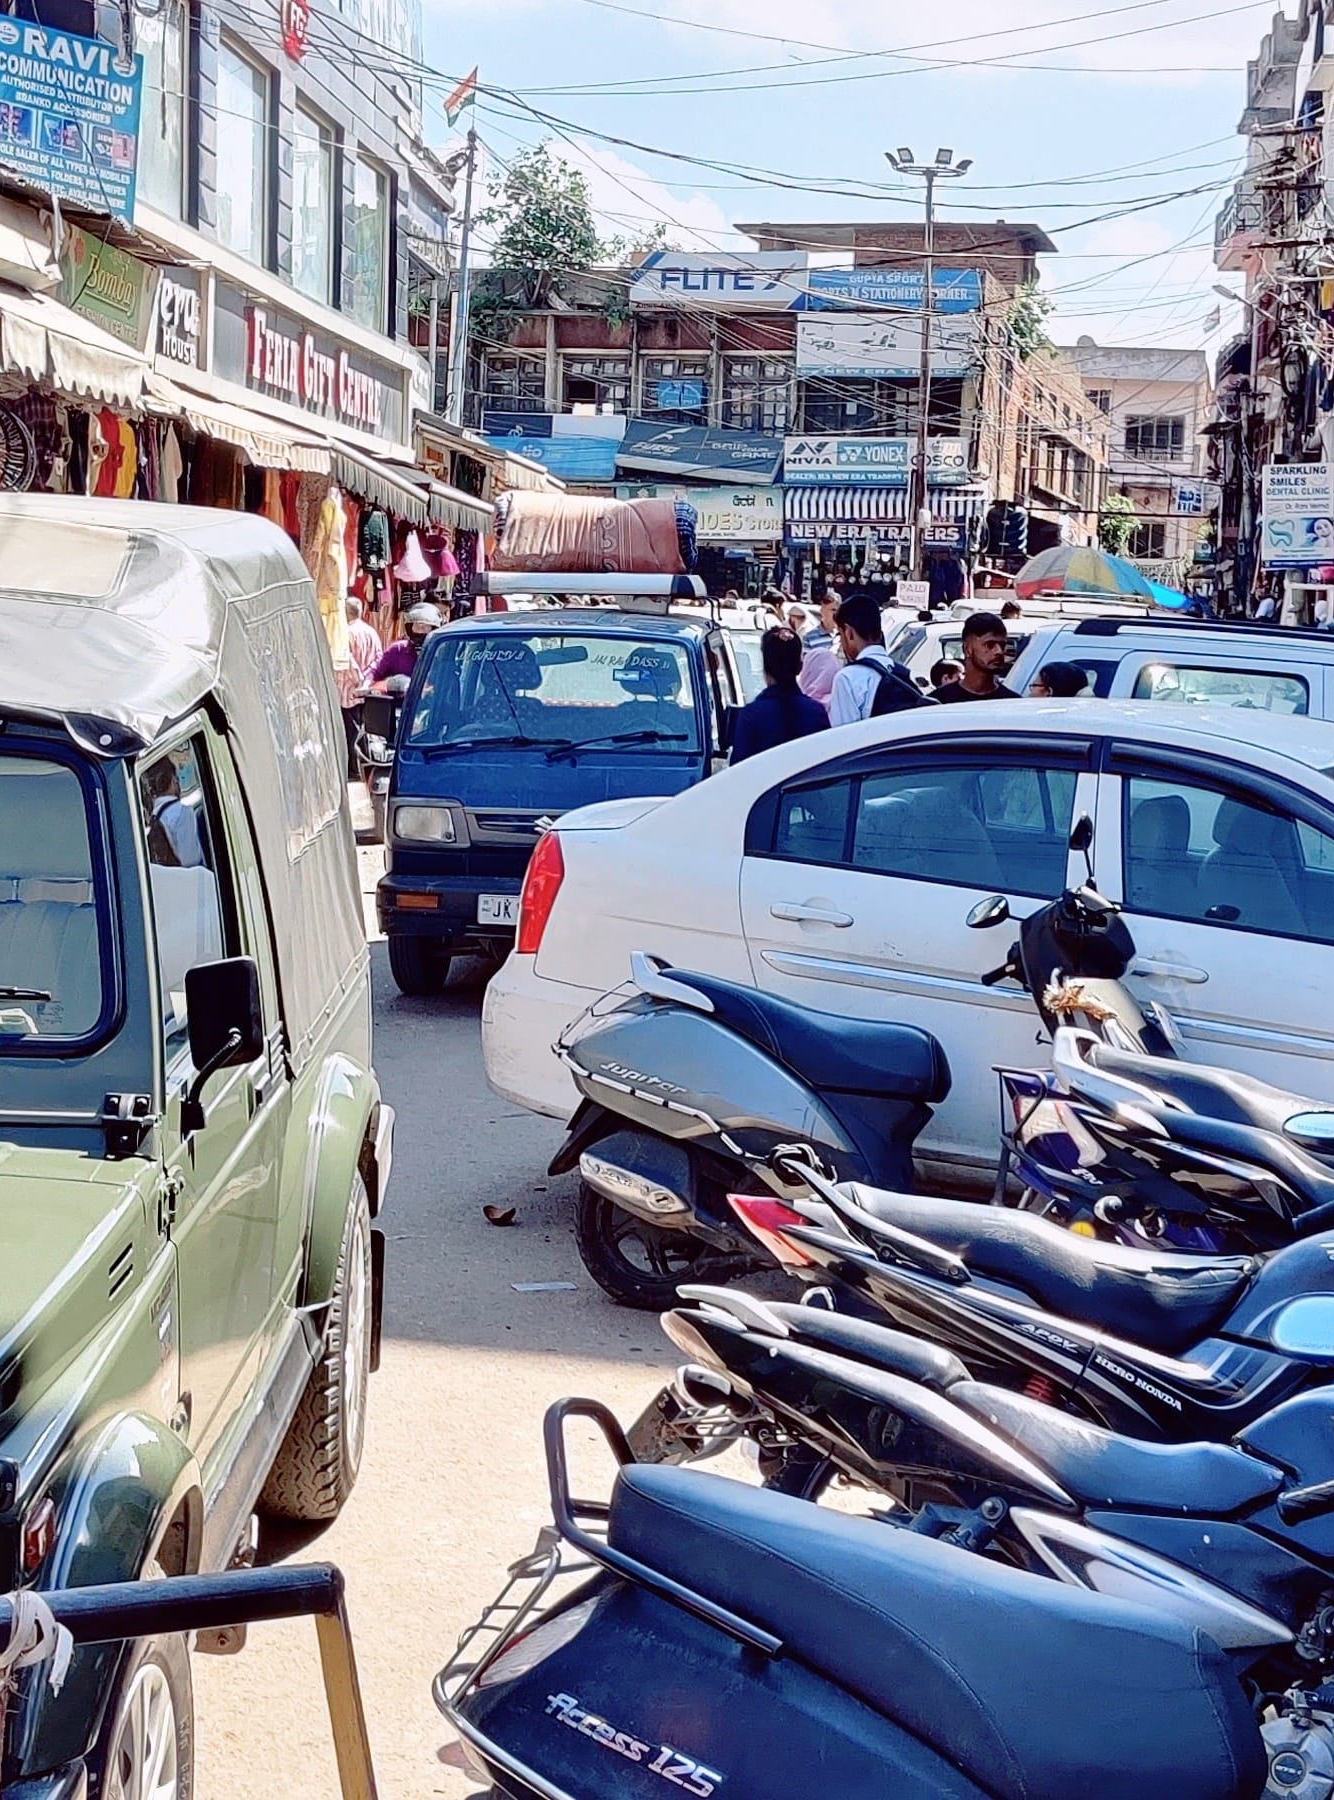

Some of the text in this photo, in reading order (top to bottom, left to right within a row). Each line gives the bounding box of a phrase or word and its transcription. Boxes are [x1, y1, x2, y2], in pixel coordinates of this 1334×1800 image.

[22, 27, 110, 76] RAVI
[1, 74, 127, 116] AUTHORISED DISTRIBUTOR OF
[50, 157, 65, 169] ALL
[88, 253, 138, 317] Bombay
[661, 267, 754, 290] FLITE
[886, 273, 925, 283] SPORT
[865, 446, 904, 463] YONEX
[1270, 466, 1327, 475] SPARKLING
[1267, 487, 1330, 496] DENTAL CLINIC
[1269, 477, 1307, 486] SMILES
[791, 525, 832, 538] NEW
[876, 526, 960, 541] TRAERS
[600, 1062, 687, 1093] Jupiter
[1095, 1353, 1183, 1412] HERO HONDA
[544, 1692, 723, 1798] Access 125
